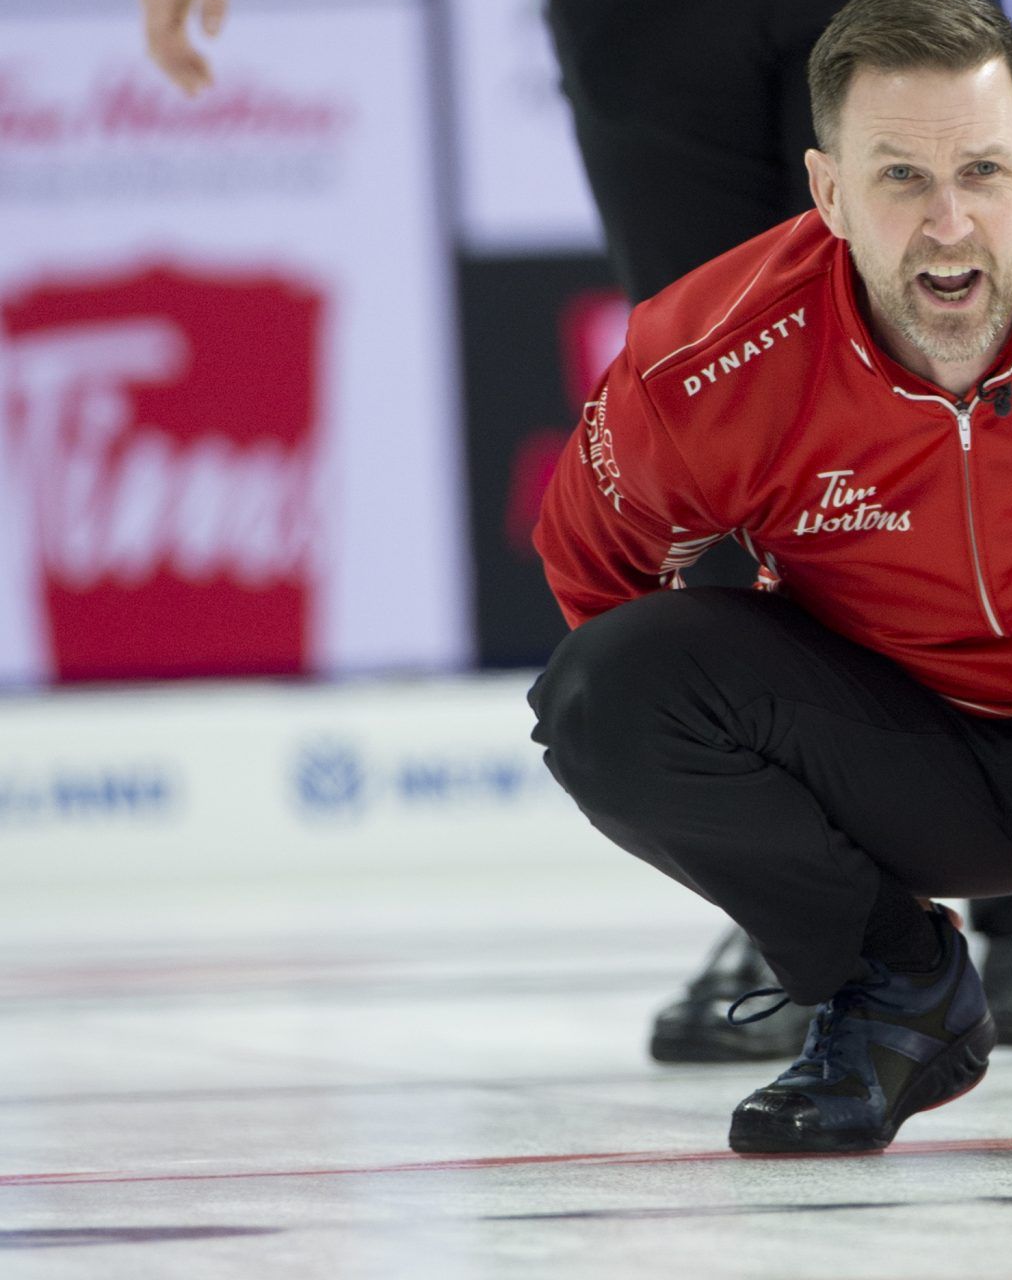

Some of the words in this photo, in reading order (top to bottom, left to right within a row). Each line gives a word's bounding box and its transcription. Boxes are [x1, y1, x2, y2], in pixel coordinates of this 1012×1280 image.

[683, 307, 806, 397] DYNASTY
[817, 469, 877, 509] Tim
[793, 502, 911, 536] Hortons
